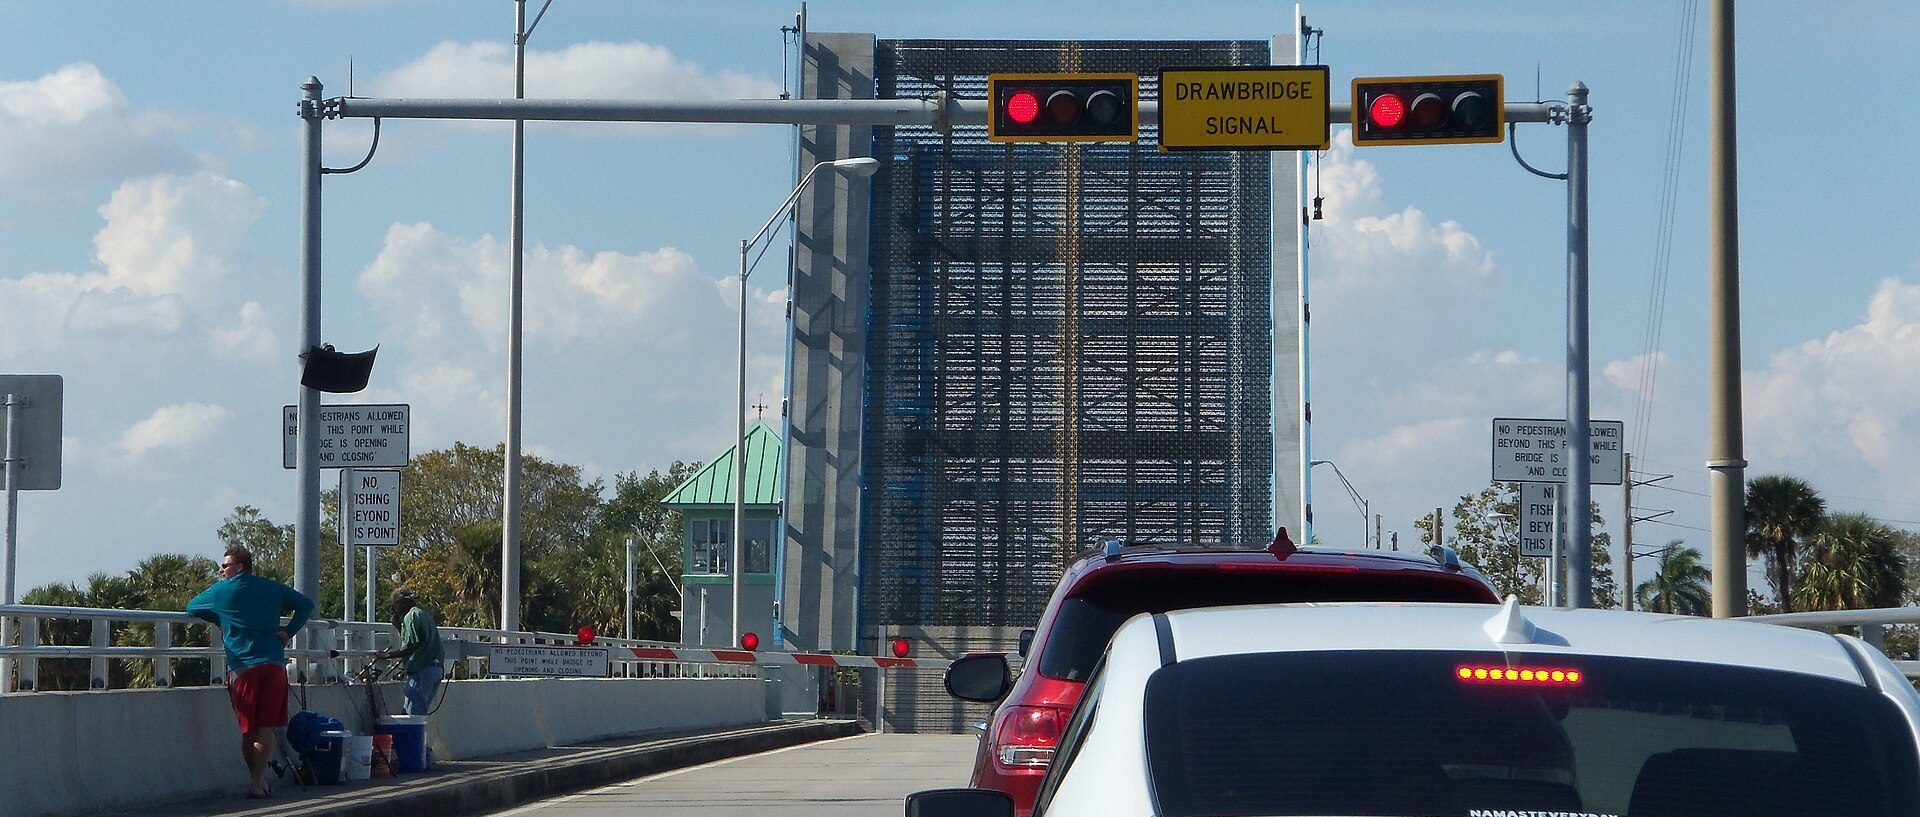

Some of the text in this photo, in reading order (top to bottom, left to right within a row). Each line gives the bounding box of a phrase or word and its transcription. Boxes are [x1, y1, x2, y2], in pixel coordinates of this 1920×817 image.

[1176, 82, 1312, 100] DRAWBRIDGE
[1206, 117, 1282, 134] SIGNAL
[320, 412, 360, 421] ESTRIANS
[367, 411, 404, 420] ALLOWED
[327, 425, 404, 434] THIS POINT WHILE
[1499, 425, 1617, 437] NO PEDESTRIAN LOWED
[340, 439, 348, 447] IS
[354, 439, 388, 447] OPENING
[1498, 439, 1530, 448] BEYOND
[1538, 440, 1555, 449] THIS
[1593, 442, 1617, 451] WHILE
[342, 452, 374, 461] CLOSING
[1515, 453, 1558, 462] BRIDGE IS
[1528, 467, 1545, 476] AND
[362, 477, 377, 488] NO
[354, 493, 390, 504] ISHING
[354, 510, 390, 521] EYOND
[354, 527, 395, 538] IS POINT
[1524, 538, 1545, 550] THIS
